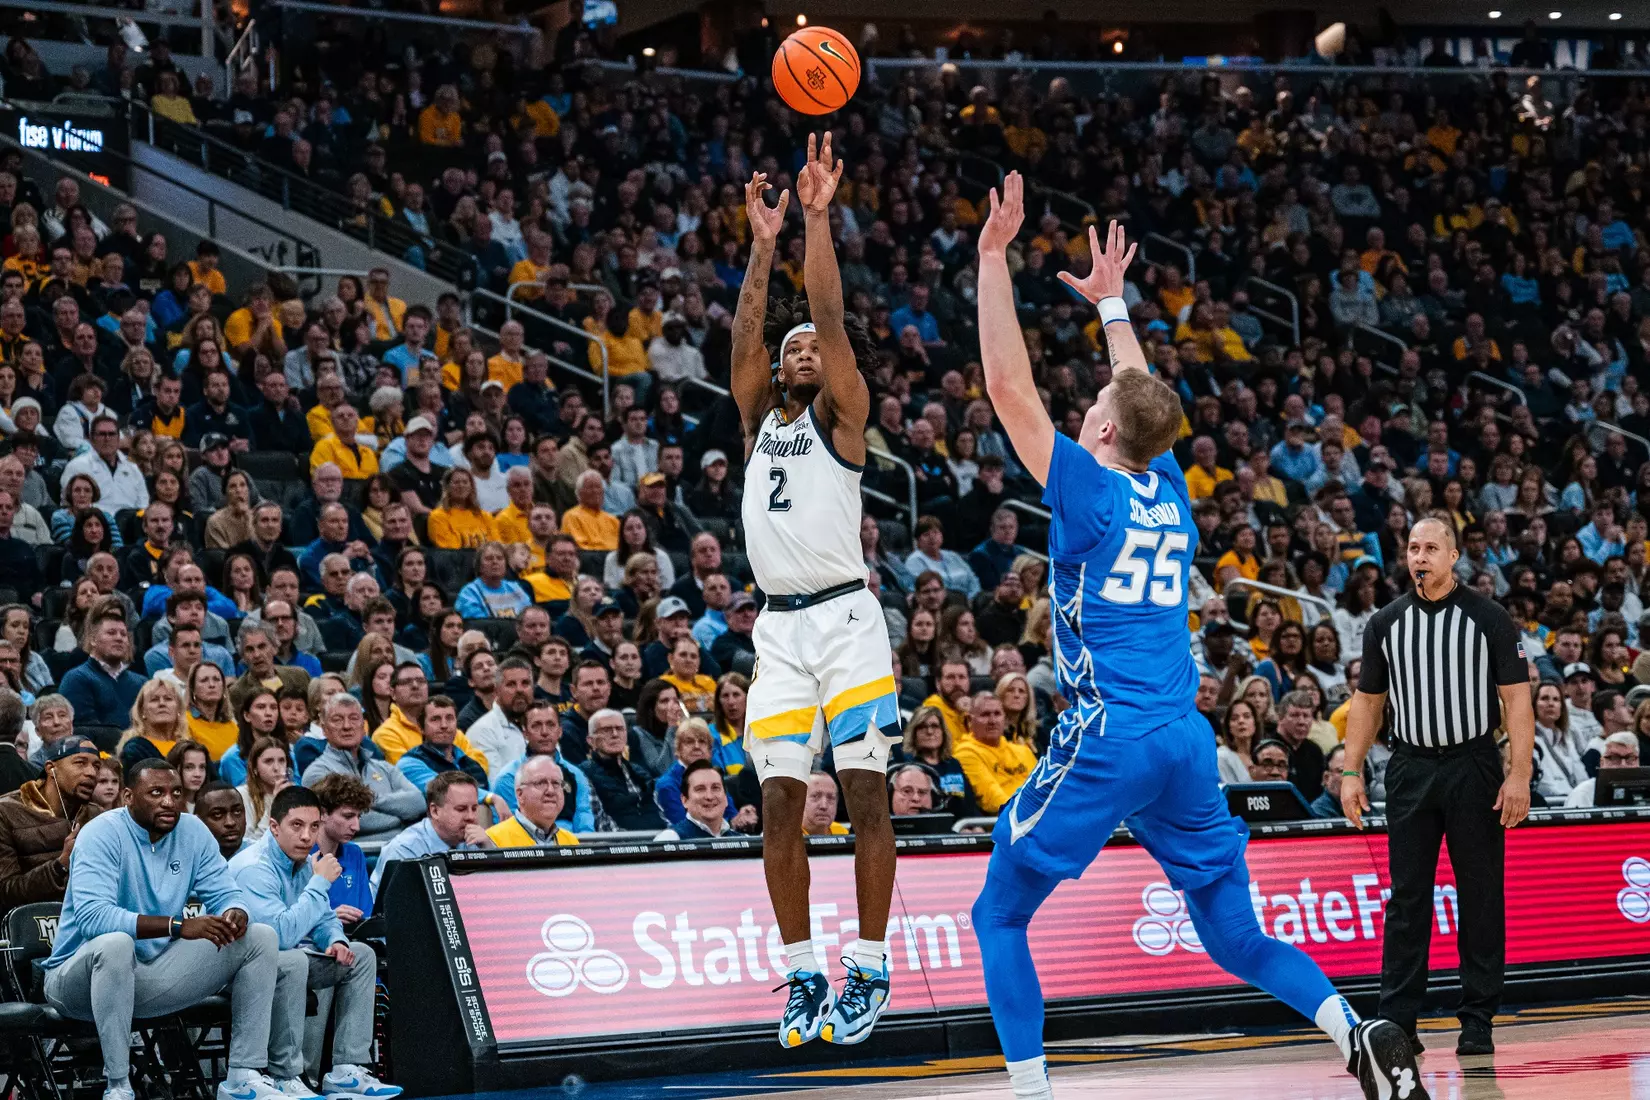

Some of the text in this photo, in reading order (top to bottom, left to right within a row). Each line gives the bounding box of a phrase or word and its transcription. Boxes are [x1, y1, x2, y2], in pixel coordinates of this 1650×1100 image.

[768, 467, 792, 512] 2
[1098, 528, 1189, 606] 55
[1247, 796, 1271, 811] POSS
[439, 905, 457, 951] IN SPORT
[445, 904, 462, 946] SCIENCE
[465, 996, 484, 1042] IN SPORT
[471, 995, 488, 1038] SCIENCE
